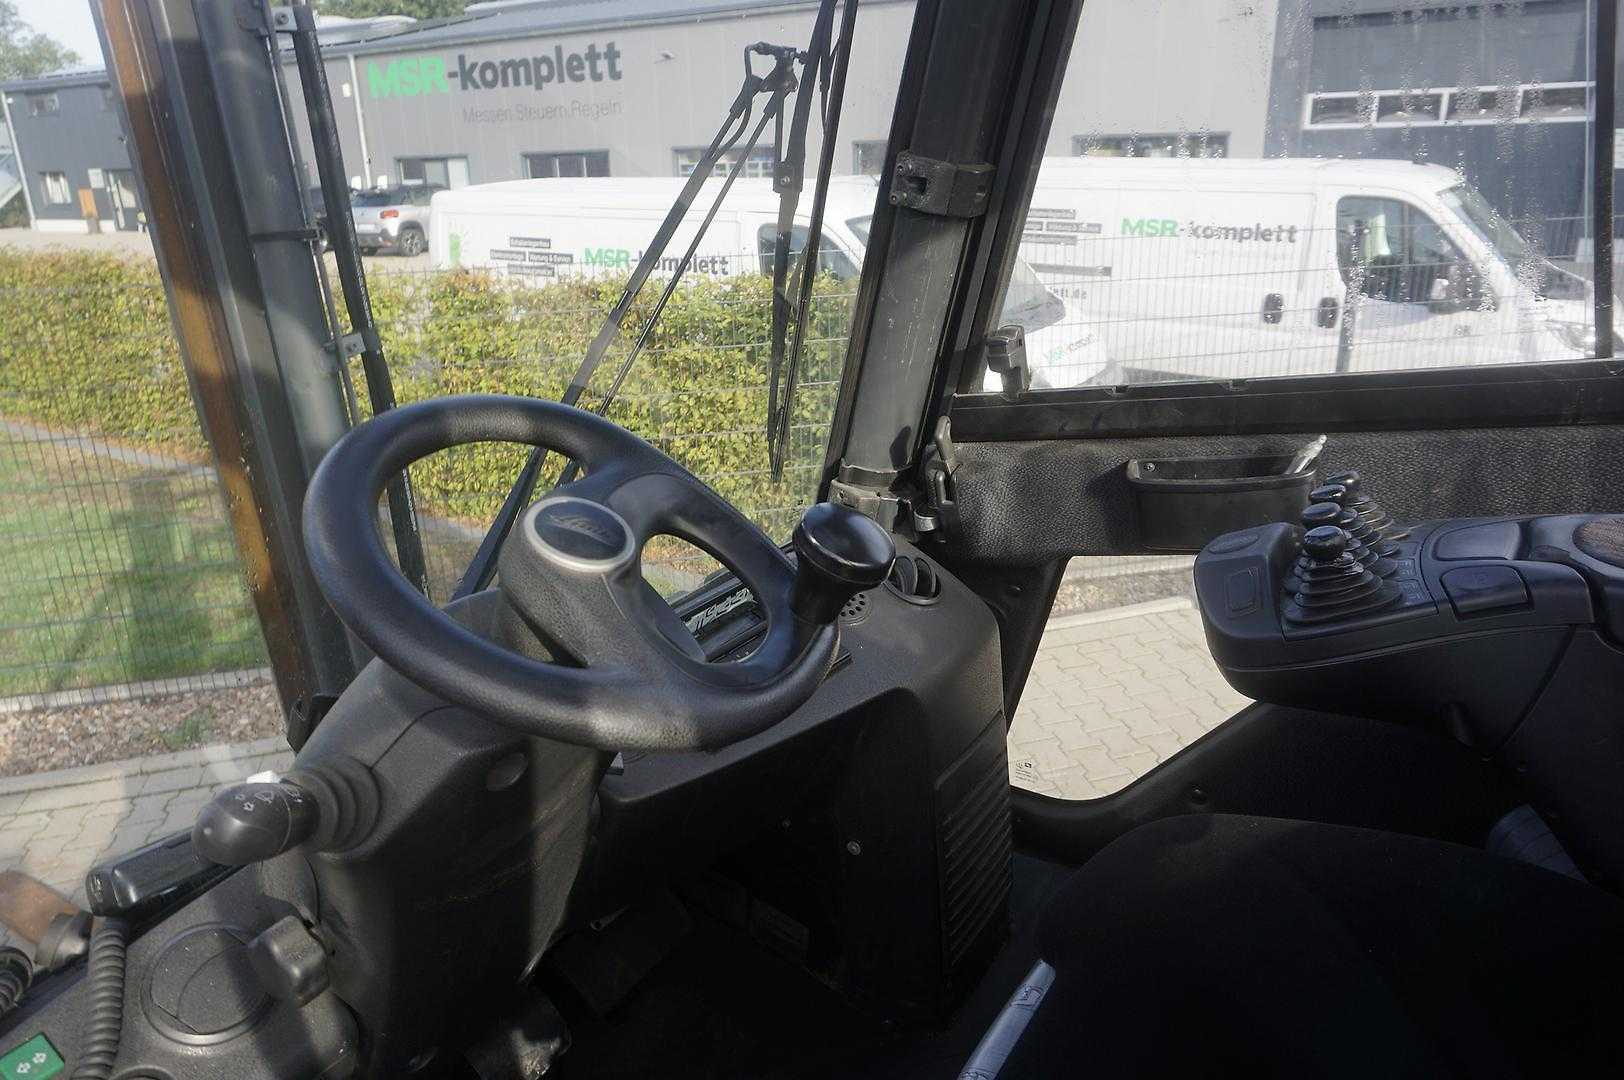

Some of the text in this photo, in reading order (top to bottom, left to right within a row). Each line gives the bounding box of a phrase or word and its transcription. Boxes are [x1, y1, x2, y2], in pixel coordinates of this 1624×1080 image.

[367, 41, 623, 98] MSR-komplett
[1120, 218, 1297, 243] MSR-komplett
[584, 247, 729, 275] MSR-omlett
